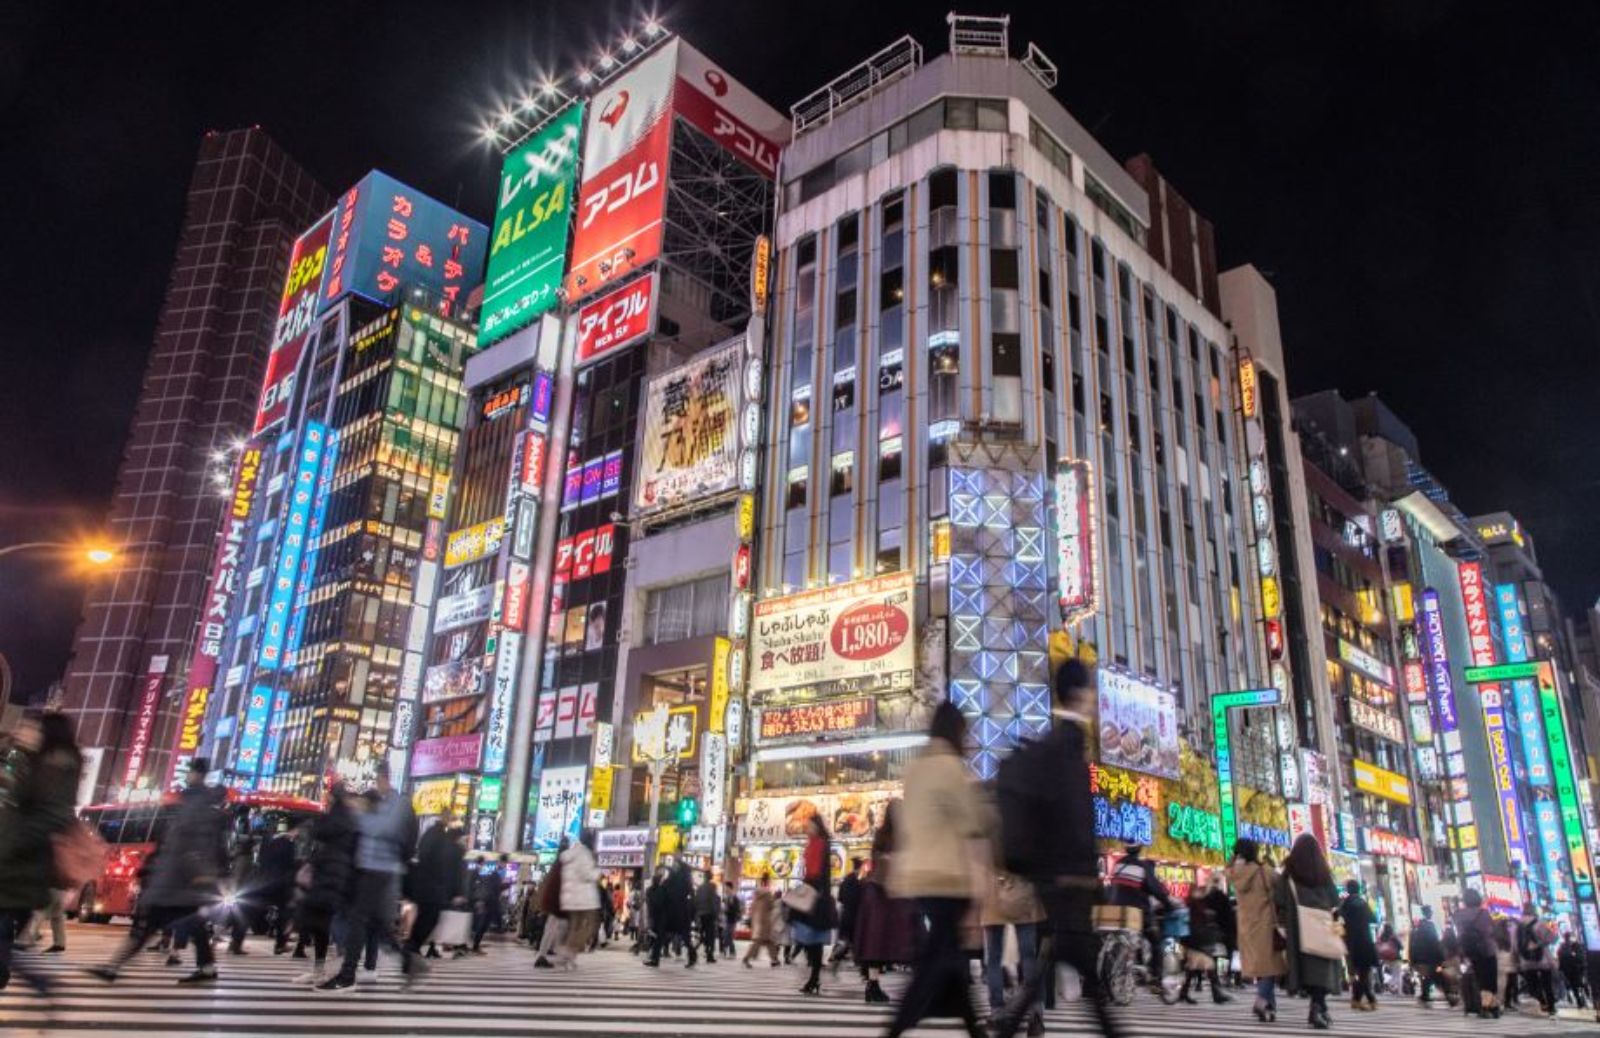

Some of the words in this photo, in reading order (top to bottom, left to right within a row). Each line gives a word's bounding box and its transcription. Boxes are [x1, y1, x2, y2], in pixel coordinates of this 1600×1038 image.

[713, 116, 774, 171] アコム
[492, 180, 565, 257] ALSA
[583, 162, 658, 229] アコム
[381, 195, 413, 293] カラオケ
[579, 291, 648, 342] アイフル
[760, 608, 830, 637] しゃぶしゃぶ
[841, 620, 888, 656] 1,980
[761, 641, 827, 671] 食べ放題!
[537, 692, 598, 725] アコム
